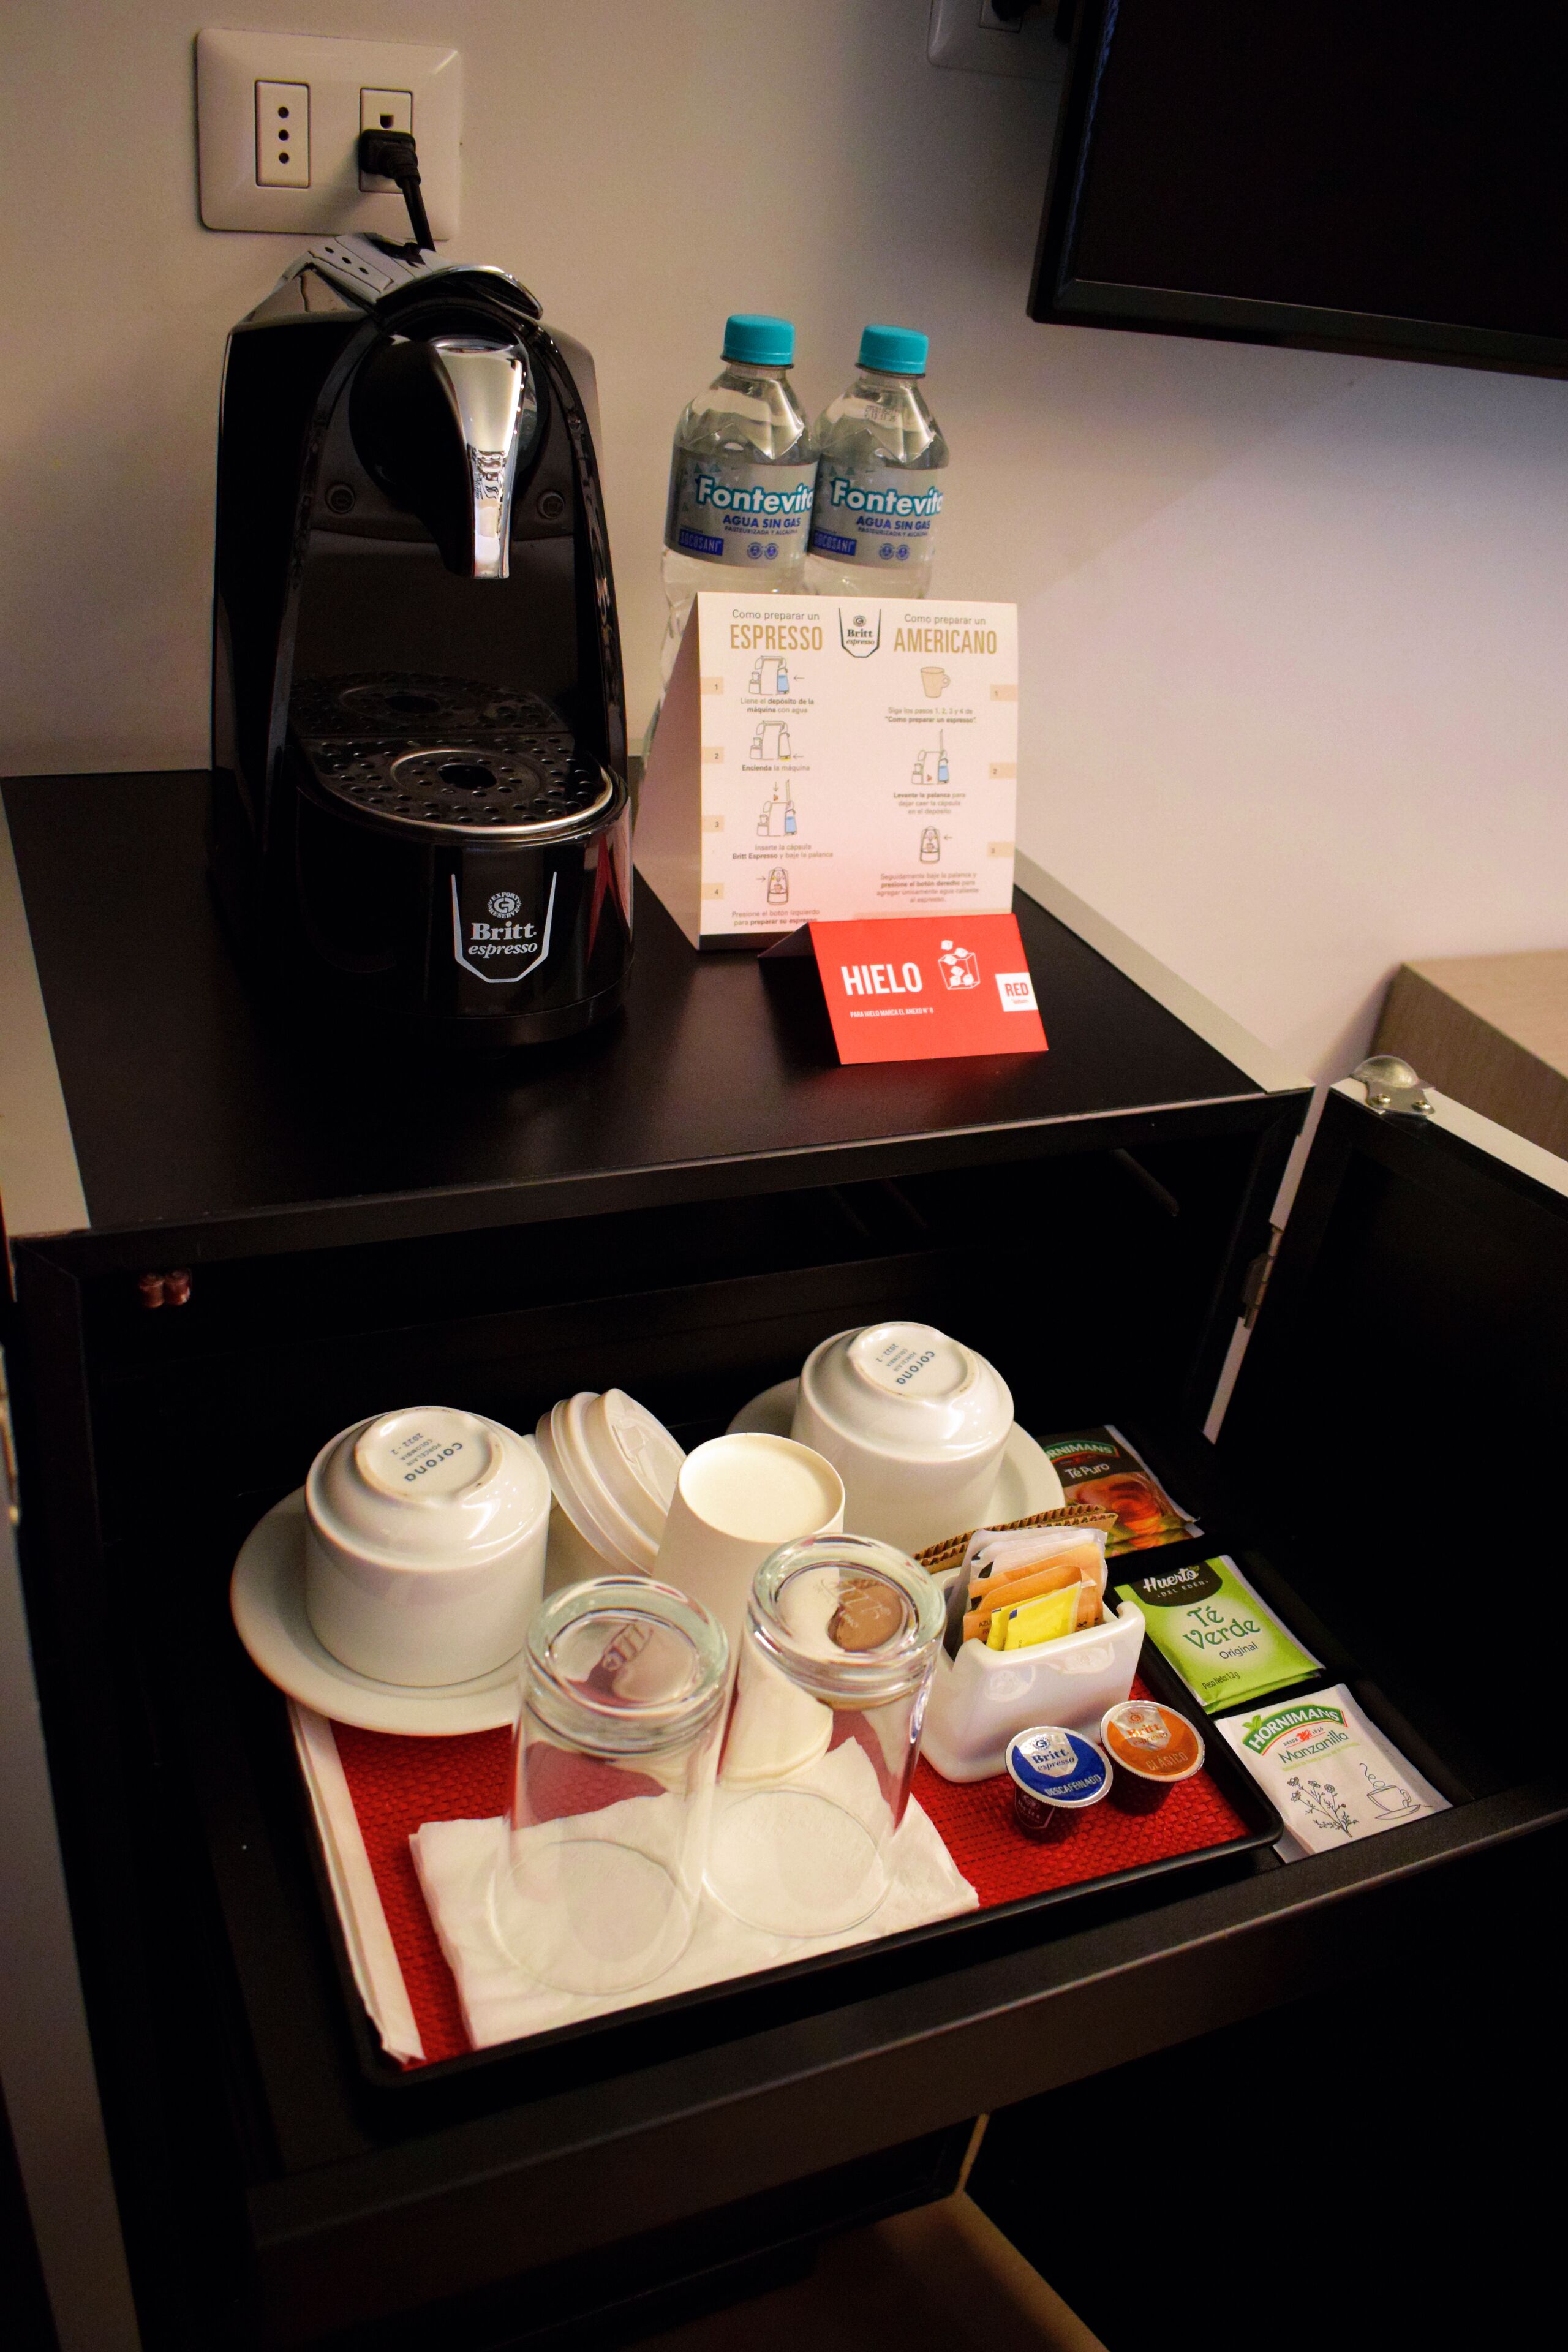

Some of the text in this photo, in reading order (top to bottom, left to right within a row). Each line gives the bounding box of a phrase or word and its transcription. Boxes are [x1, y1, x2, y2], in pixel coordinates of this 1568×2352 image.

[723, 514, 801, 529] AGUA SIN GAS
[857, 516, 930, 530] AGUA SIN GAS
[732, 609, 761, 619] Como
[764, 612, 804, 621] preparar
[905, 613, 931, 623] Como
[934, 615, 971, 625] preparar
[731, 624, 823, 650] ESPRESSO
[847, 628, 873, 638] Britt
[894, 628, 997, 654] AMERICANO
[747, 706, 776, 714] máquina
[468, 943, 538, 959] espresso
[841, 962, 922, 995] HIELO
[1005, 982, 1029, 997] RED
[895, 1351, 935, 1385] corona
[402, 1433, 424, 1447] 2022
[400, 1439, 433, 1461] COLOMBIA
[406, 1442, 442, 1466] PORCELAIN
[1046, 1442, 1113, 1458] RNIMANS
[404, 1442, 463, 1482] corona
[1064, 1467, 1083, 1479] Té
[1079, 1462, 1110, 1476] Puro
[1143, 1567, 1199, 1593] Huerto
[979, 1618, 992, 1628] AZU
[1187, 1605, 1224, 1627] Té
[1182, 1618, 1261, 1650] Verde
[1219, 1642, 1259, 1659] Original
[1202, 1679, 1215, 1690] Peso
[1127, 1723, 1161, 1737] Britt
[1249, 1708, 1340, 1751] HORNIMANS
[1278, 1730, 1349, 1764] Manzanilla
[1038, 1757, 1075, 1771] espresso
[1145, 1752, 1188, 1771] CLÁSICO
[1044, 1774, 1102, 1796] DESCAFEINADO
